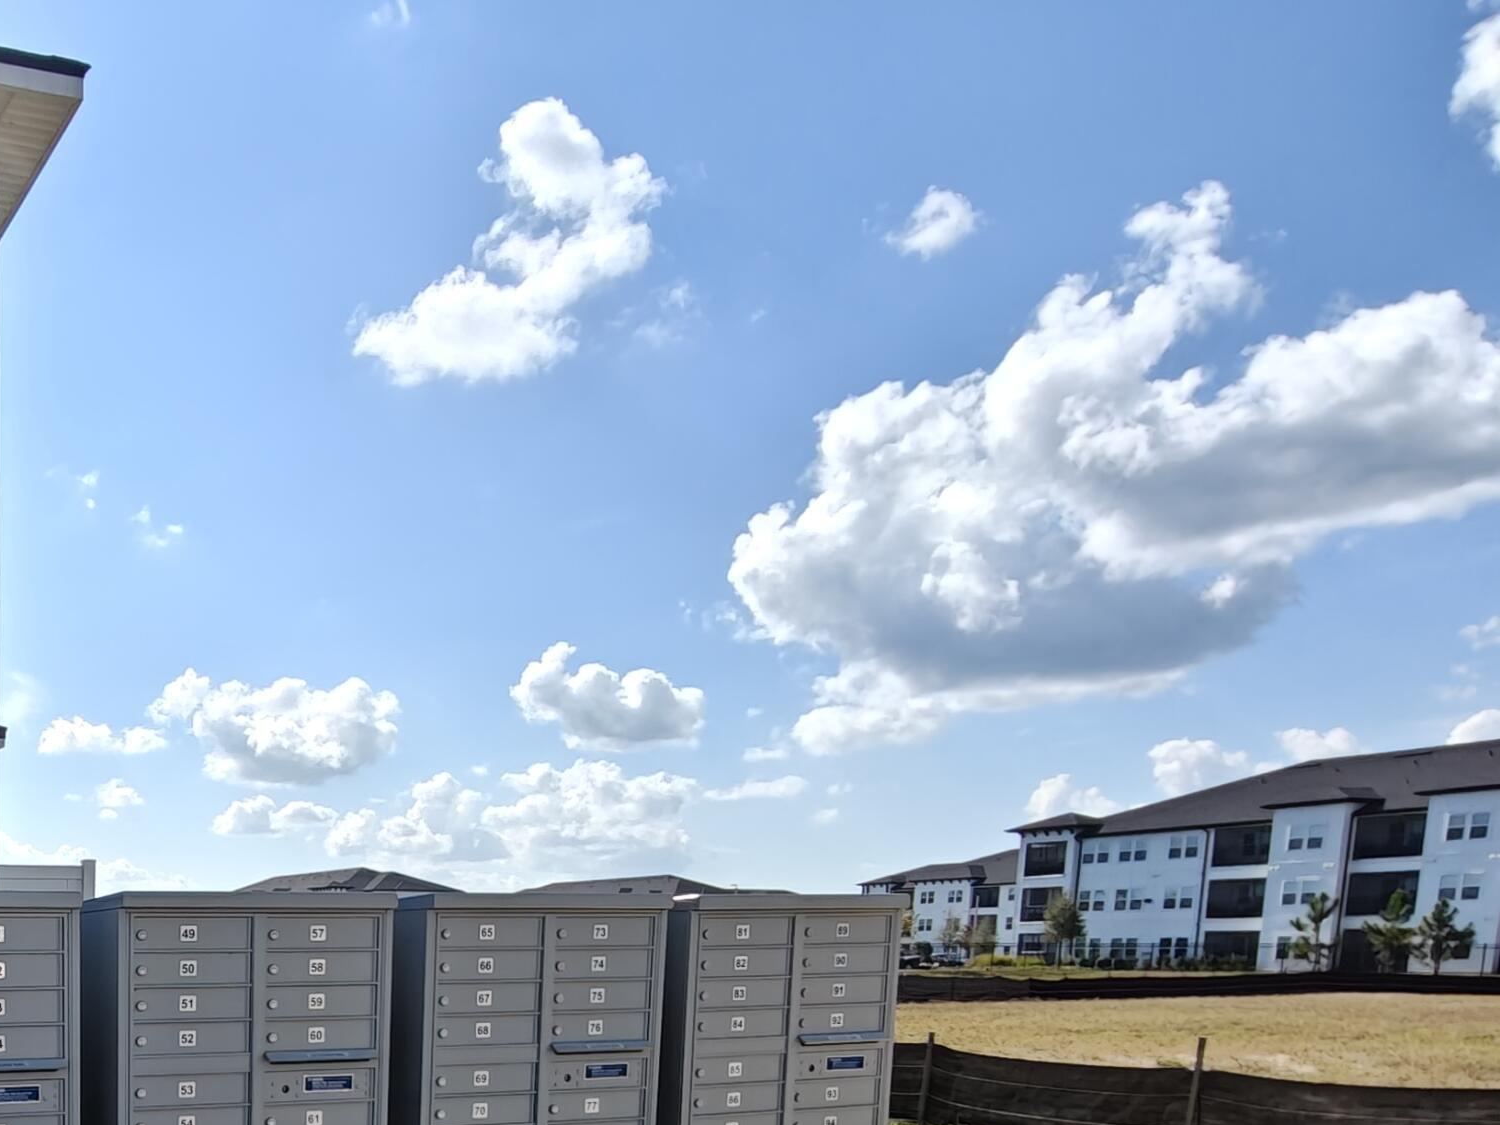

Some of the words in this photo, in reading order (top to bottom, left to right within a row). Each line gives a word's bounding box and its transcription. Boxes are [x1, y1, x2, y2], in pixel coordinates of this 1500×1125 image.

[181, 928, 196, 939] 49
[311, 928, 325, 939] 57
[481, 927, 493, 938] 65
[595, 927, 606, 938] 73
[182, 963, 195, 974] 50
[310, 962, 324, 973] 58
[479, 960, 492, 971] 66
[593, 959, 604, 969] 74
[310, 996, 323, 1007] 59
[478, 993, 490, 1004] 67
[592, 991, 603, 1001] 75
[181, 998, 194, 1009] 51
[477, 1025, 489, 1036] 68
[590, 1022, 602, 1033] 76
[181, 1033, 194, 1044] 52
[309, 1030, 323, 1041] 60
[475, 1073, 487, 1084] 69
[180, 1084, 194, 1096] 53
[474, 1106, 486, 1116] 70
[586, 1101, 598, 1110] 77
[307, 1114, 319, 1124] 61
